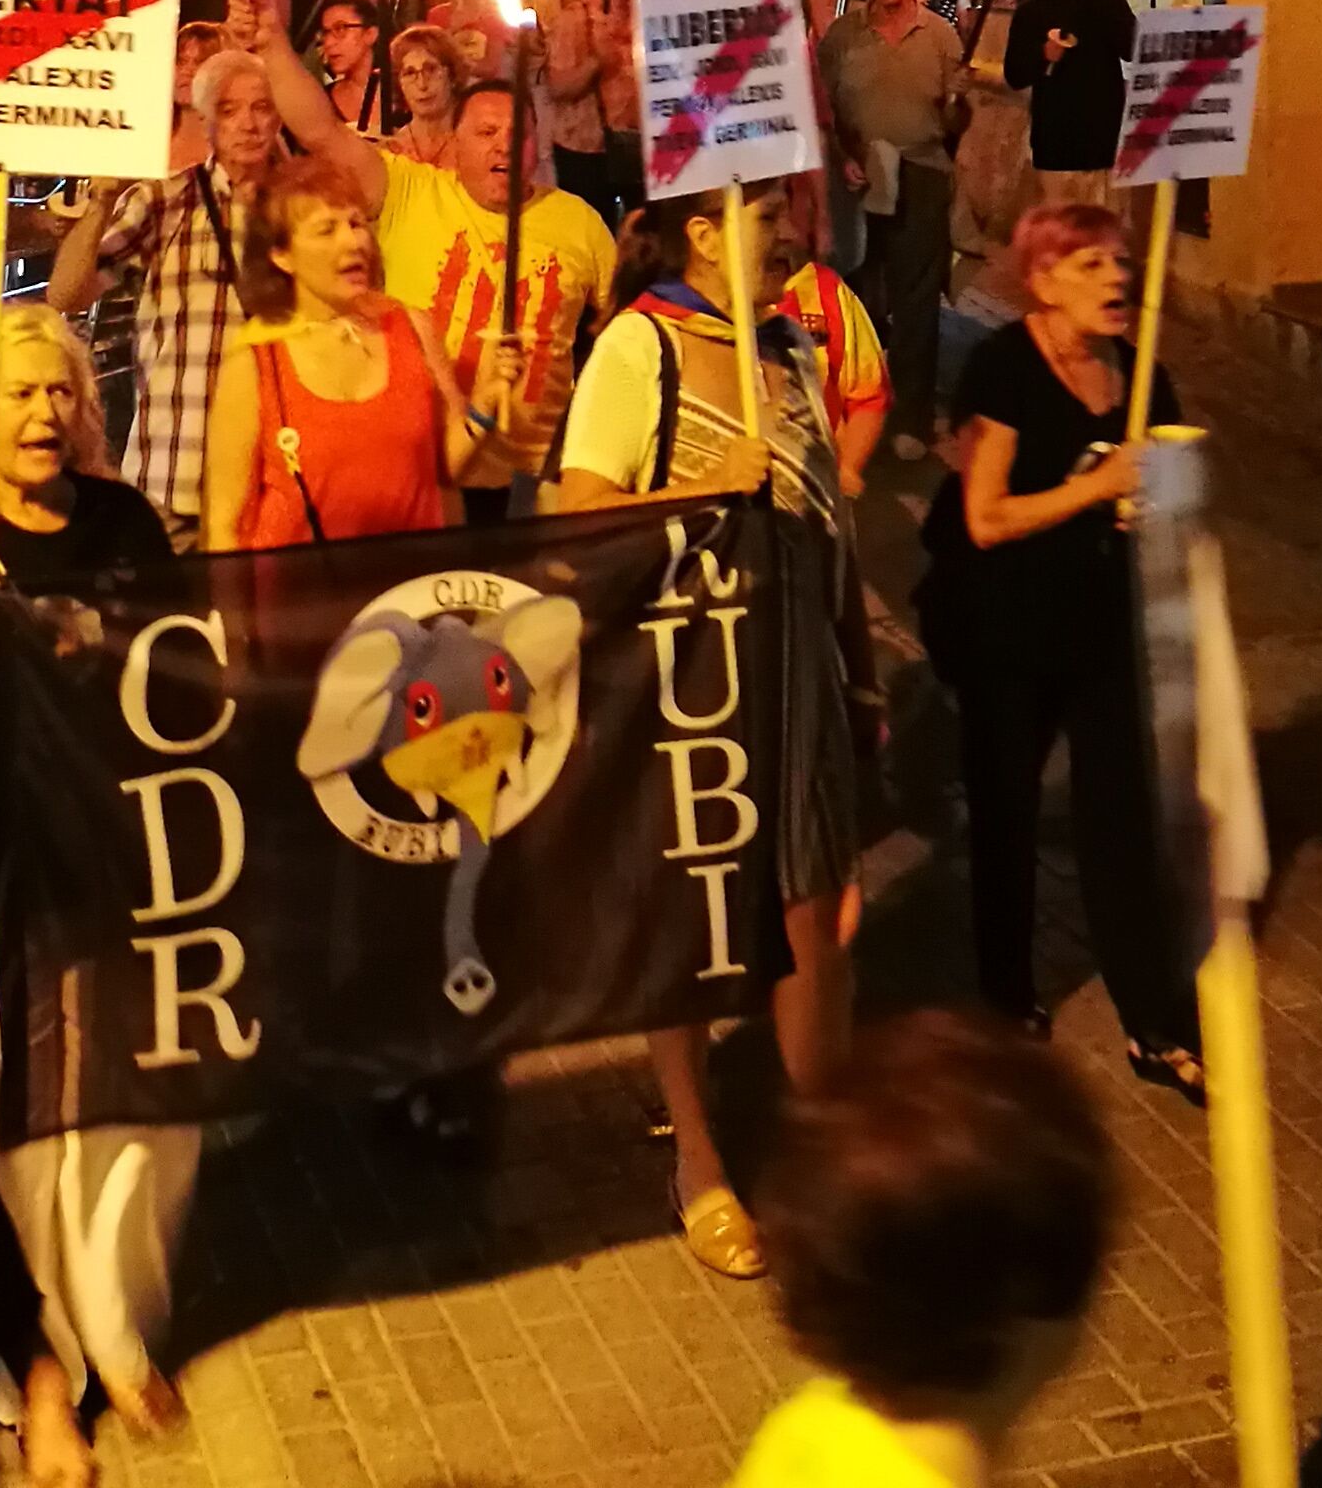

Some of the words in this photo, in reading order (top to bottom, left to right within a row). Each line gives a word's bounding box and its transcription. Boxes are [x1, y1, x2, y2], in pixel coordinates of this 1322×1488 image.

[6, 64, 116, 91] ALEXIS
[431, 578, 504, 611] CDR
[119, 609, 263, 1070] CDR
